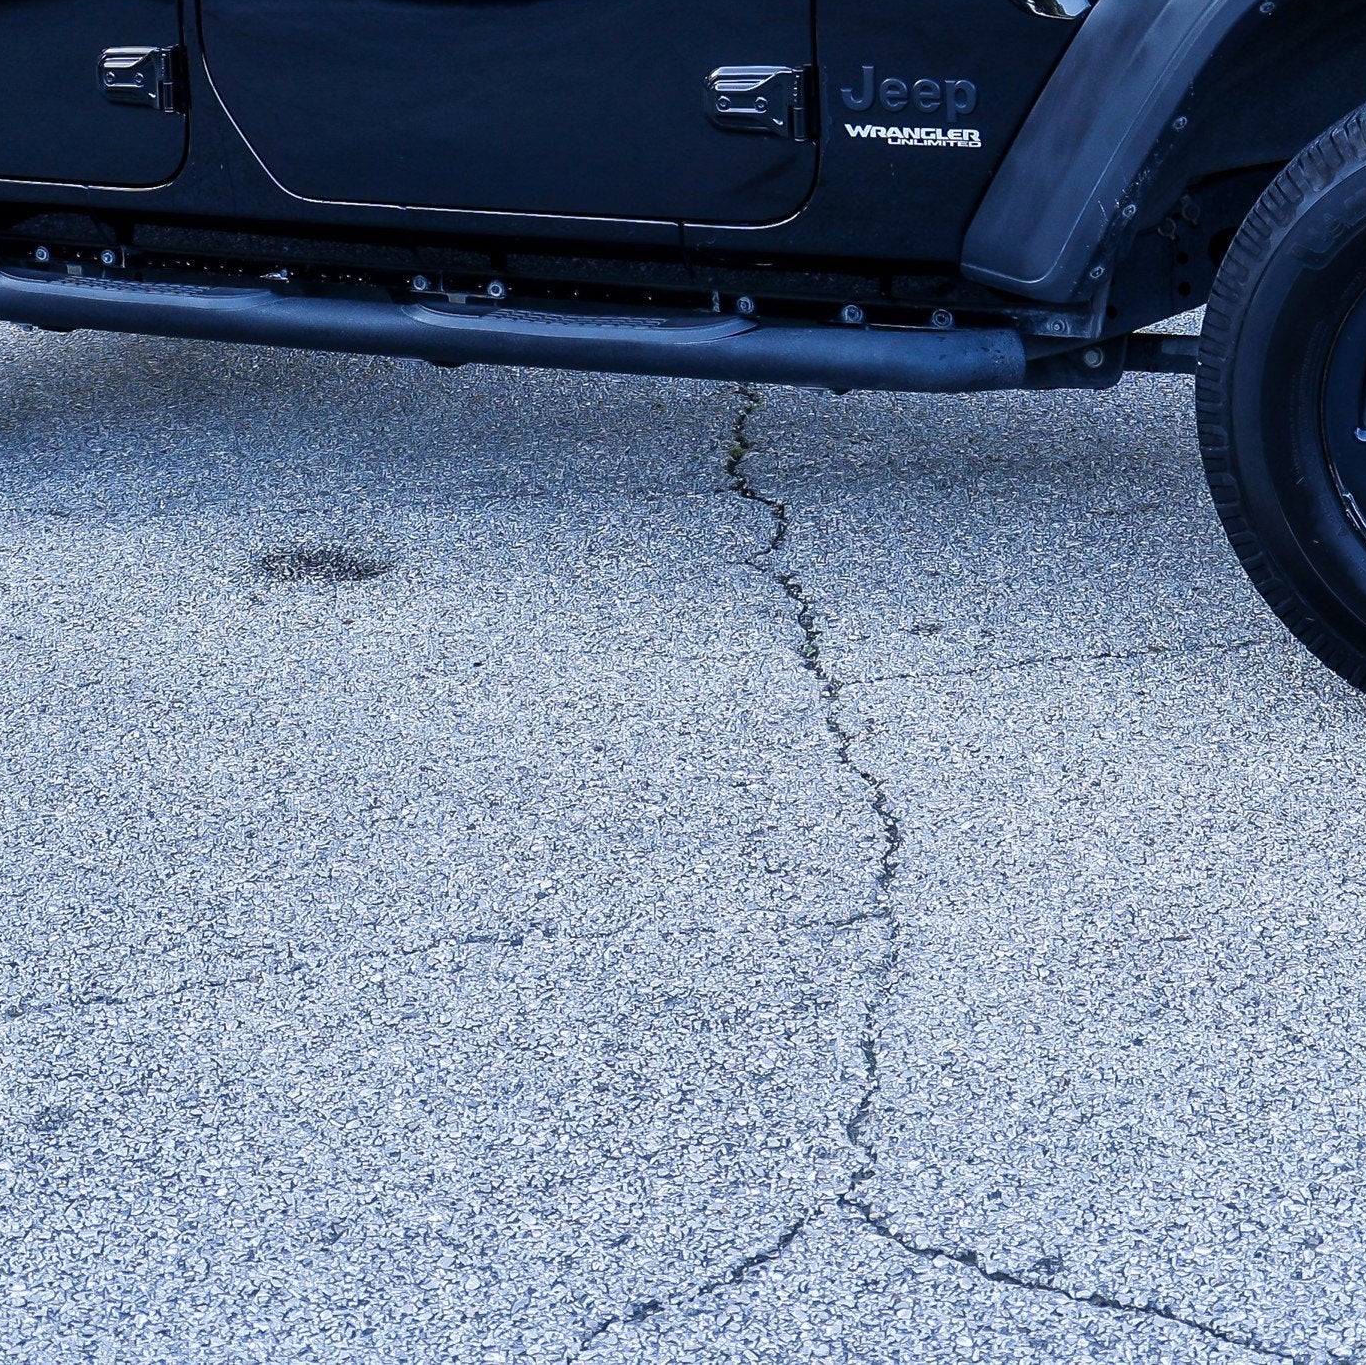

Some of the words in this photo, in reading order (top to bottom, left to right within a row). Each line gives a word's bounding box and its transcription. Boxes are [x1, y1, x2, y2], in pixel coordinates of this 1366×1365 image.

[840, 65, 977, 123] Jeep
[844, 123, 980, 141] WRANGLER
[887, 138, 982, 148] UNLIMITED
